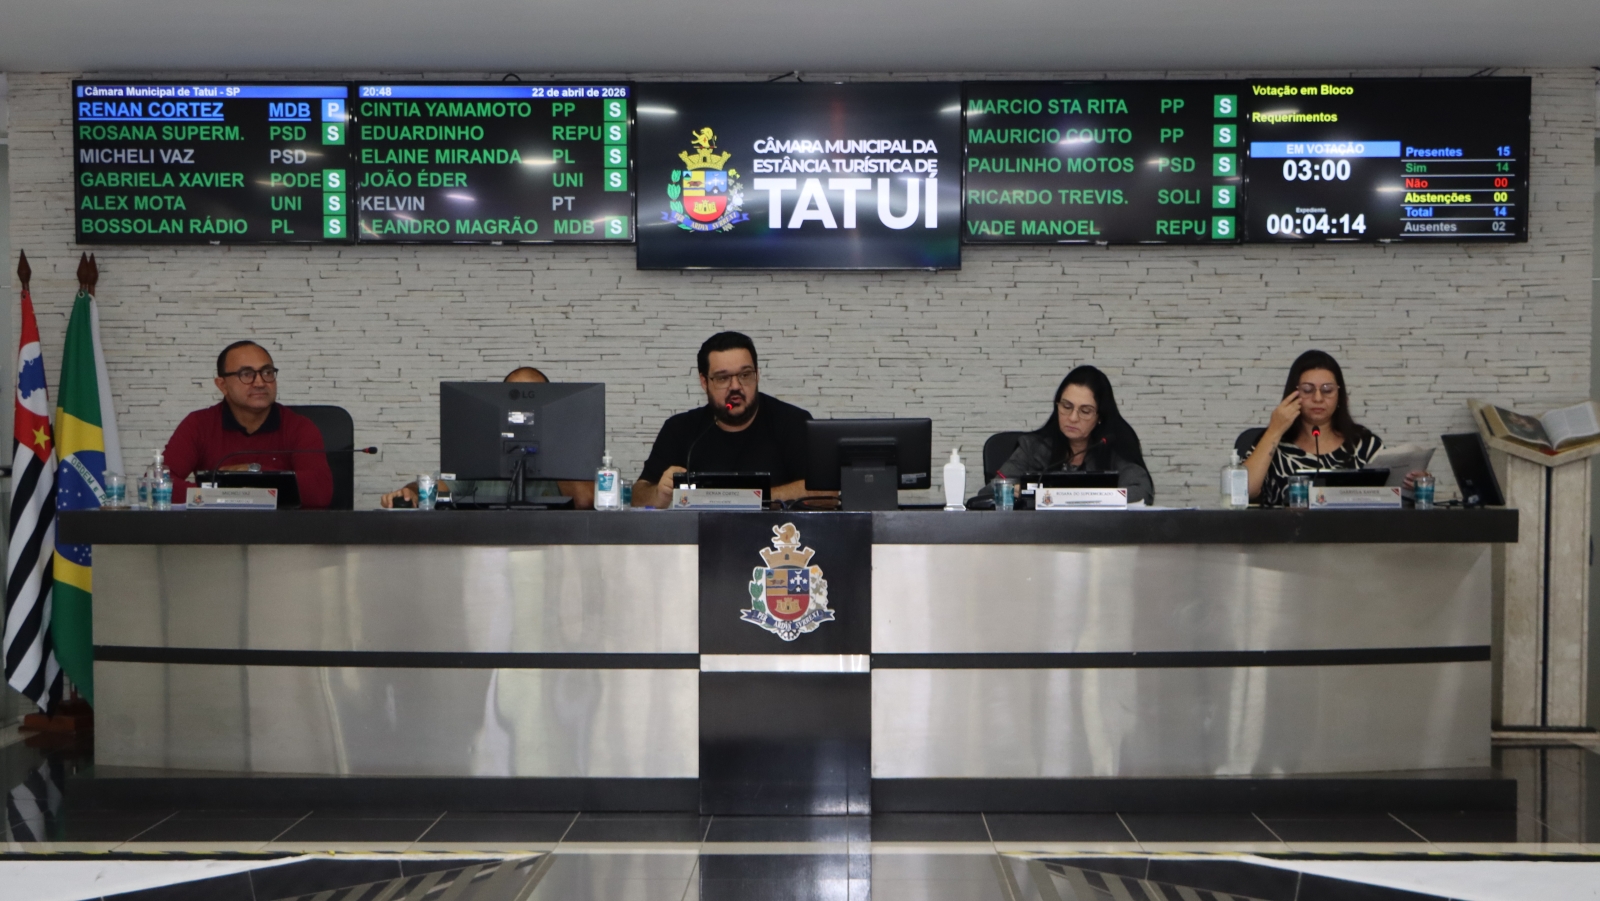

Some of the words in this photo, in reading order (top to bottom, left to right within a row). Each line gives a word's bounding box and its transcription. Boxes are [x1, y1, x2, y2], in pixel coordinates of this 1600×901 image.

[85, 87, 123, 96] Câmara
[126, 87, 175, 99] Municipal
[178, 87, 190, 97] de
[226, 87, 240, 97] SP
[363, 88, 392, 97] 20:48
[532, 88, 544, 97] 22
[547, 88, 559, 97] de
[562, 88, 584, 97] abril
[587, 88, 599, 97] de
[602, 88, 626, 97] 2026
[1252, 85, 1298, 97] Votação
[1300, 87, 1317, 95] em
[1321, 85, 1353, 95] Bloco
[79, 102, 142, 118] RENAN
[148, 102, 224, 118] CORTEZ
[269, 103, 311, 118] MDB
[328, 103, 339, 116] P
[361, 102, 421, 117] CINTIA
[425, 102, 531, 117] YAMAMOTO
[552, 103, 575, 117] PP
[609, 103, 621, 117] S
[969, 99, 1042, 114] MARCIO
[1048, 100, 1082, 114] STA
[1088, 100, 1128, 114] RITA
[1161, 99, 1184, 113] PP
[1219, 99, 1231, 114] S
[1252, 112, 1338, 124] Requerimentos
[80, 126, 157, 140] ROSANA
[162, 126, 244, 141] SUPERM.
[270, 126, 306, 140] PSD
[328, 126, 339, 141] S
[361, 126, 484, 140] EDUARDINHO
[552, 126, 602, 140] REPU
[609, 126, 621, 141] S
[969, 128, 1060, 143] MAURICIO
[1066, 129, 1132, 143] COUTO
[1160, 128, 1184, 143] PP
[1219, 128, 1230, 143] S
[754, 136, 824, 154] CÂMARA
[825, 139, 910, 154] MUNICIPAL
[913, 139, 937, 154] DA
[1287, 144, 1303, 154] EM
[1306, 143, 1364, 156] VOTAÇÃO
[1406, 147, 1463, 157] Presentes
[1497, 147, 1510, 157] 15
[80, 149, 154, 164] MICHELI
[159, 149, 195, 163] VAZ
[271, 149, 307, 164] PSD
[361, 149, 429, 164] ELAINE
[435, 149, 521, 164] MIRANDA
[553, 149, 575, 164] PL
[610, 149, 621, 164] S
[754, 156, 830, 173] ESTÂNCIA
[831, 156, 913, 173] TURÍSTICA
[915, 160, 937, 173] DE
[968, 158, 1061, 173] PAULINHO
[1068, 157, 1134, 173] MOTOS
[1158, 158, 1195, 172] PSD
[1218, 157, 1230, 172] S
[1283, 159, 1351, 181] 03:00
[1406, 163, 1427, 173] Sim
[1496, 163, 1509, 172] 14
[80, 172, 174, 187] GABRIELA
[179, 173, 244, 187] XAVIER
[271, 173, 321, 187] PODE
[328, 173, 340, 188] S
[361, 170, 412, 187] JOÃO
[418, 169, 467, 187] ÉDER
[553, 173, 583, 187] UNI
[610, 172, 621, 187] S
[1406, 178, 1428, 188] Não
[1494, 178, 1508, 187] 00
[81, 196, 128, 210] ALEX
[134, 196, 186, 210] MOTA
[271, 196, 302, 210] UNI
[329, 196, 340, 211] S
[361, 196, 425, 210] KELVIN
[552, 196, 575, 210] PT
[754, 172, 937, 230] TATUÍ
[968, 190, 1052, 205] RICARDO
[1058, 190, 1128, 204] TREVIS.
[1158, 189, 1200, 204] SOLI
[1218, 189, 1230, 204] S
[1405, 193, 1471, 204] Abstenções
[1494, 193, 1507, 202] 00
[1405, 207, 1432, 217] Total
[1494, 207, 1506, 216] 14
[82, 219, 183, 234] BOSSOLAN
[190, 216, 248, 234] RÁDIO
[272, 220, 294, 234] PL
[329, 219, 341, 234] S
[361, 220, 450, 234] LEANDRO
[456, 217, 538, 234] MAGRÃO
[555, 220, 595, 234] MDB
[610, 220, 622, 234] S
[968, 221, 1015, 235] VADE
[1022, 220, 1100, 235] MANOEL
[1156, 220, 1206, 235] REPU
[1218, 220, 1229, 234] S
[1267, 214, 1366, 234] 00:04:14
[1404, 222, 1457, 232] Ausentes
[1492, 222, 1506, 231] 02
[71, 457, 95, 484] ORDEM
